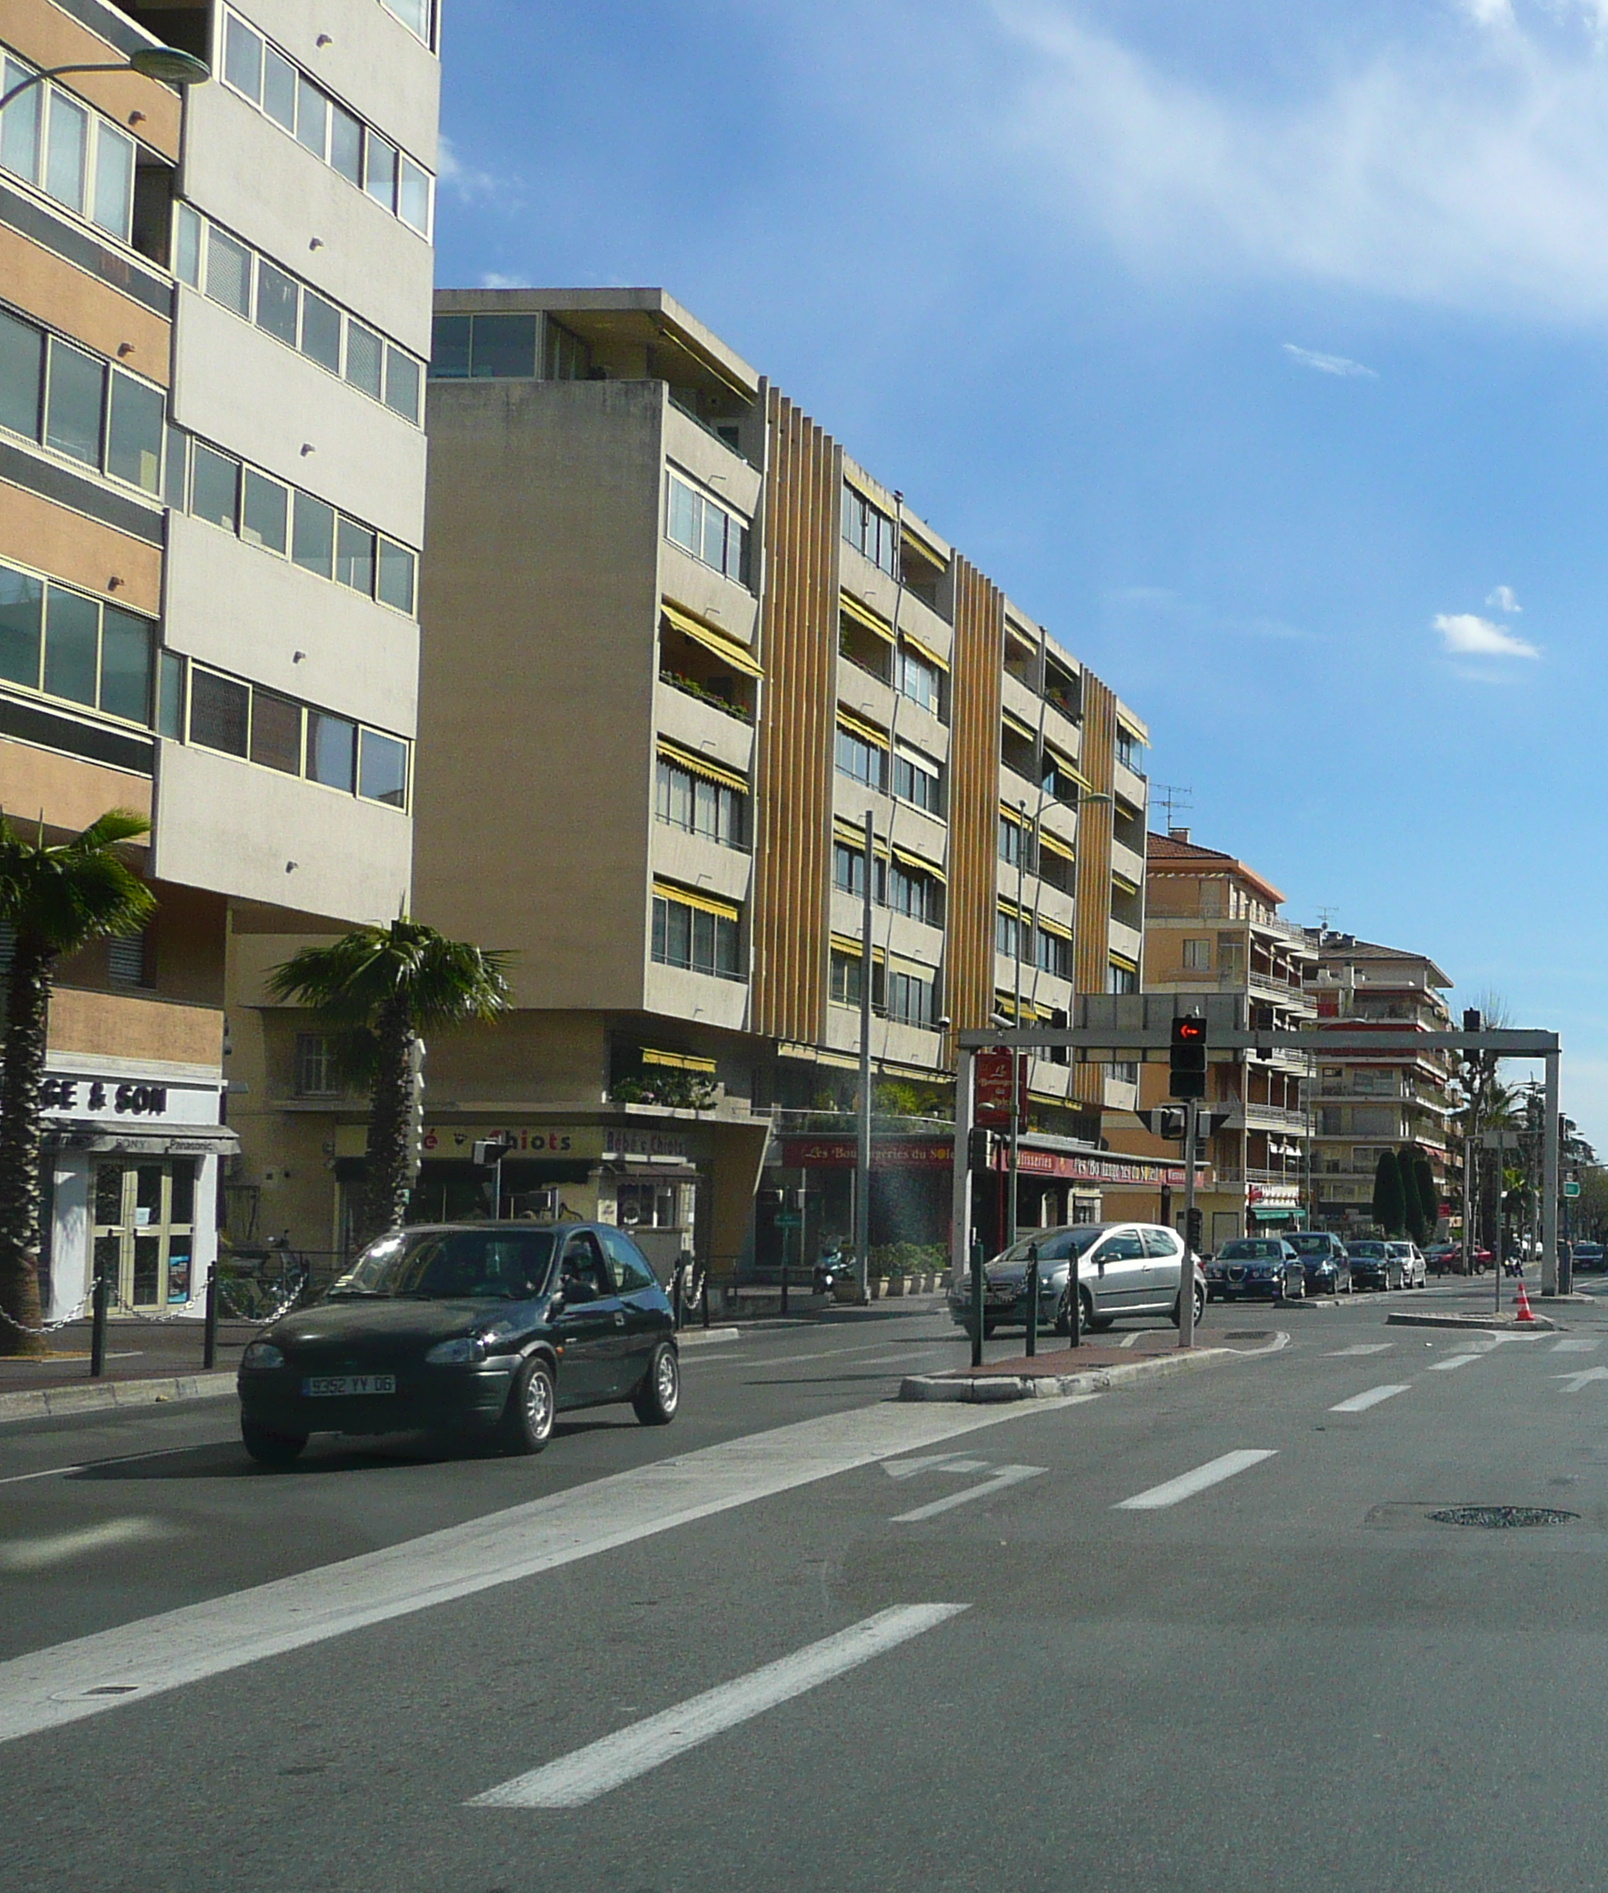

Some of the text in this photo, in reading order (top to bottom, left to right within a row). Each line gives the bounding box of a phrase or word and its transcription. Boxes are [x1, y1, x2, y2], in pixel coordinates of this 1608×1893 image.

[88, 1082, 107, 1112] &
[114, 1084, 168, 1116] SON
[169, 1138, 213, 1152] Panasonic
[832, 1148, 909, 1164] Bougeries
[911, 1149, 927, 1160] du
[1015, 1150, 1052, 1169] tisseries
